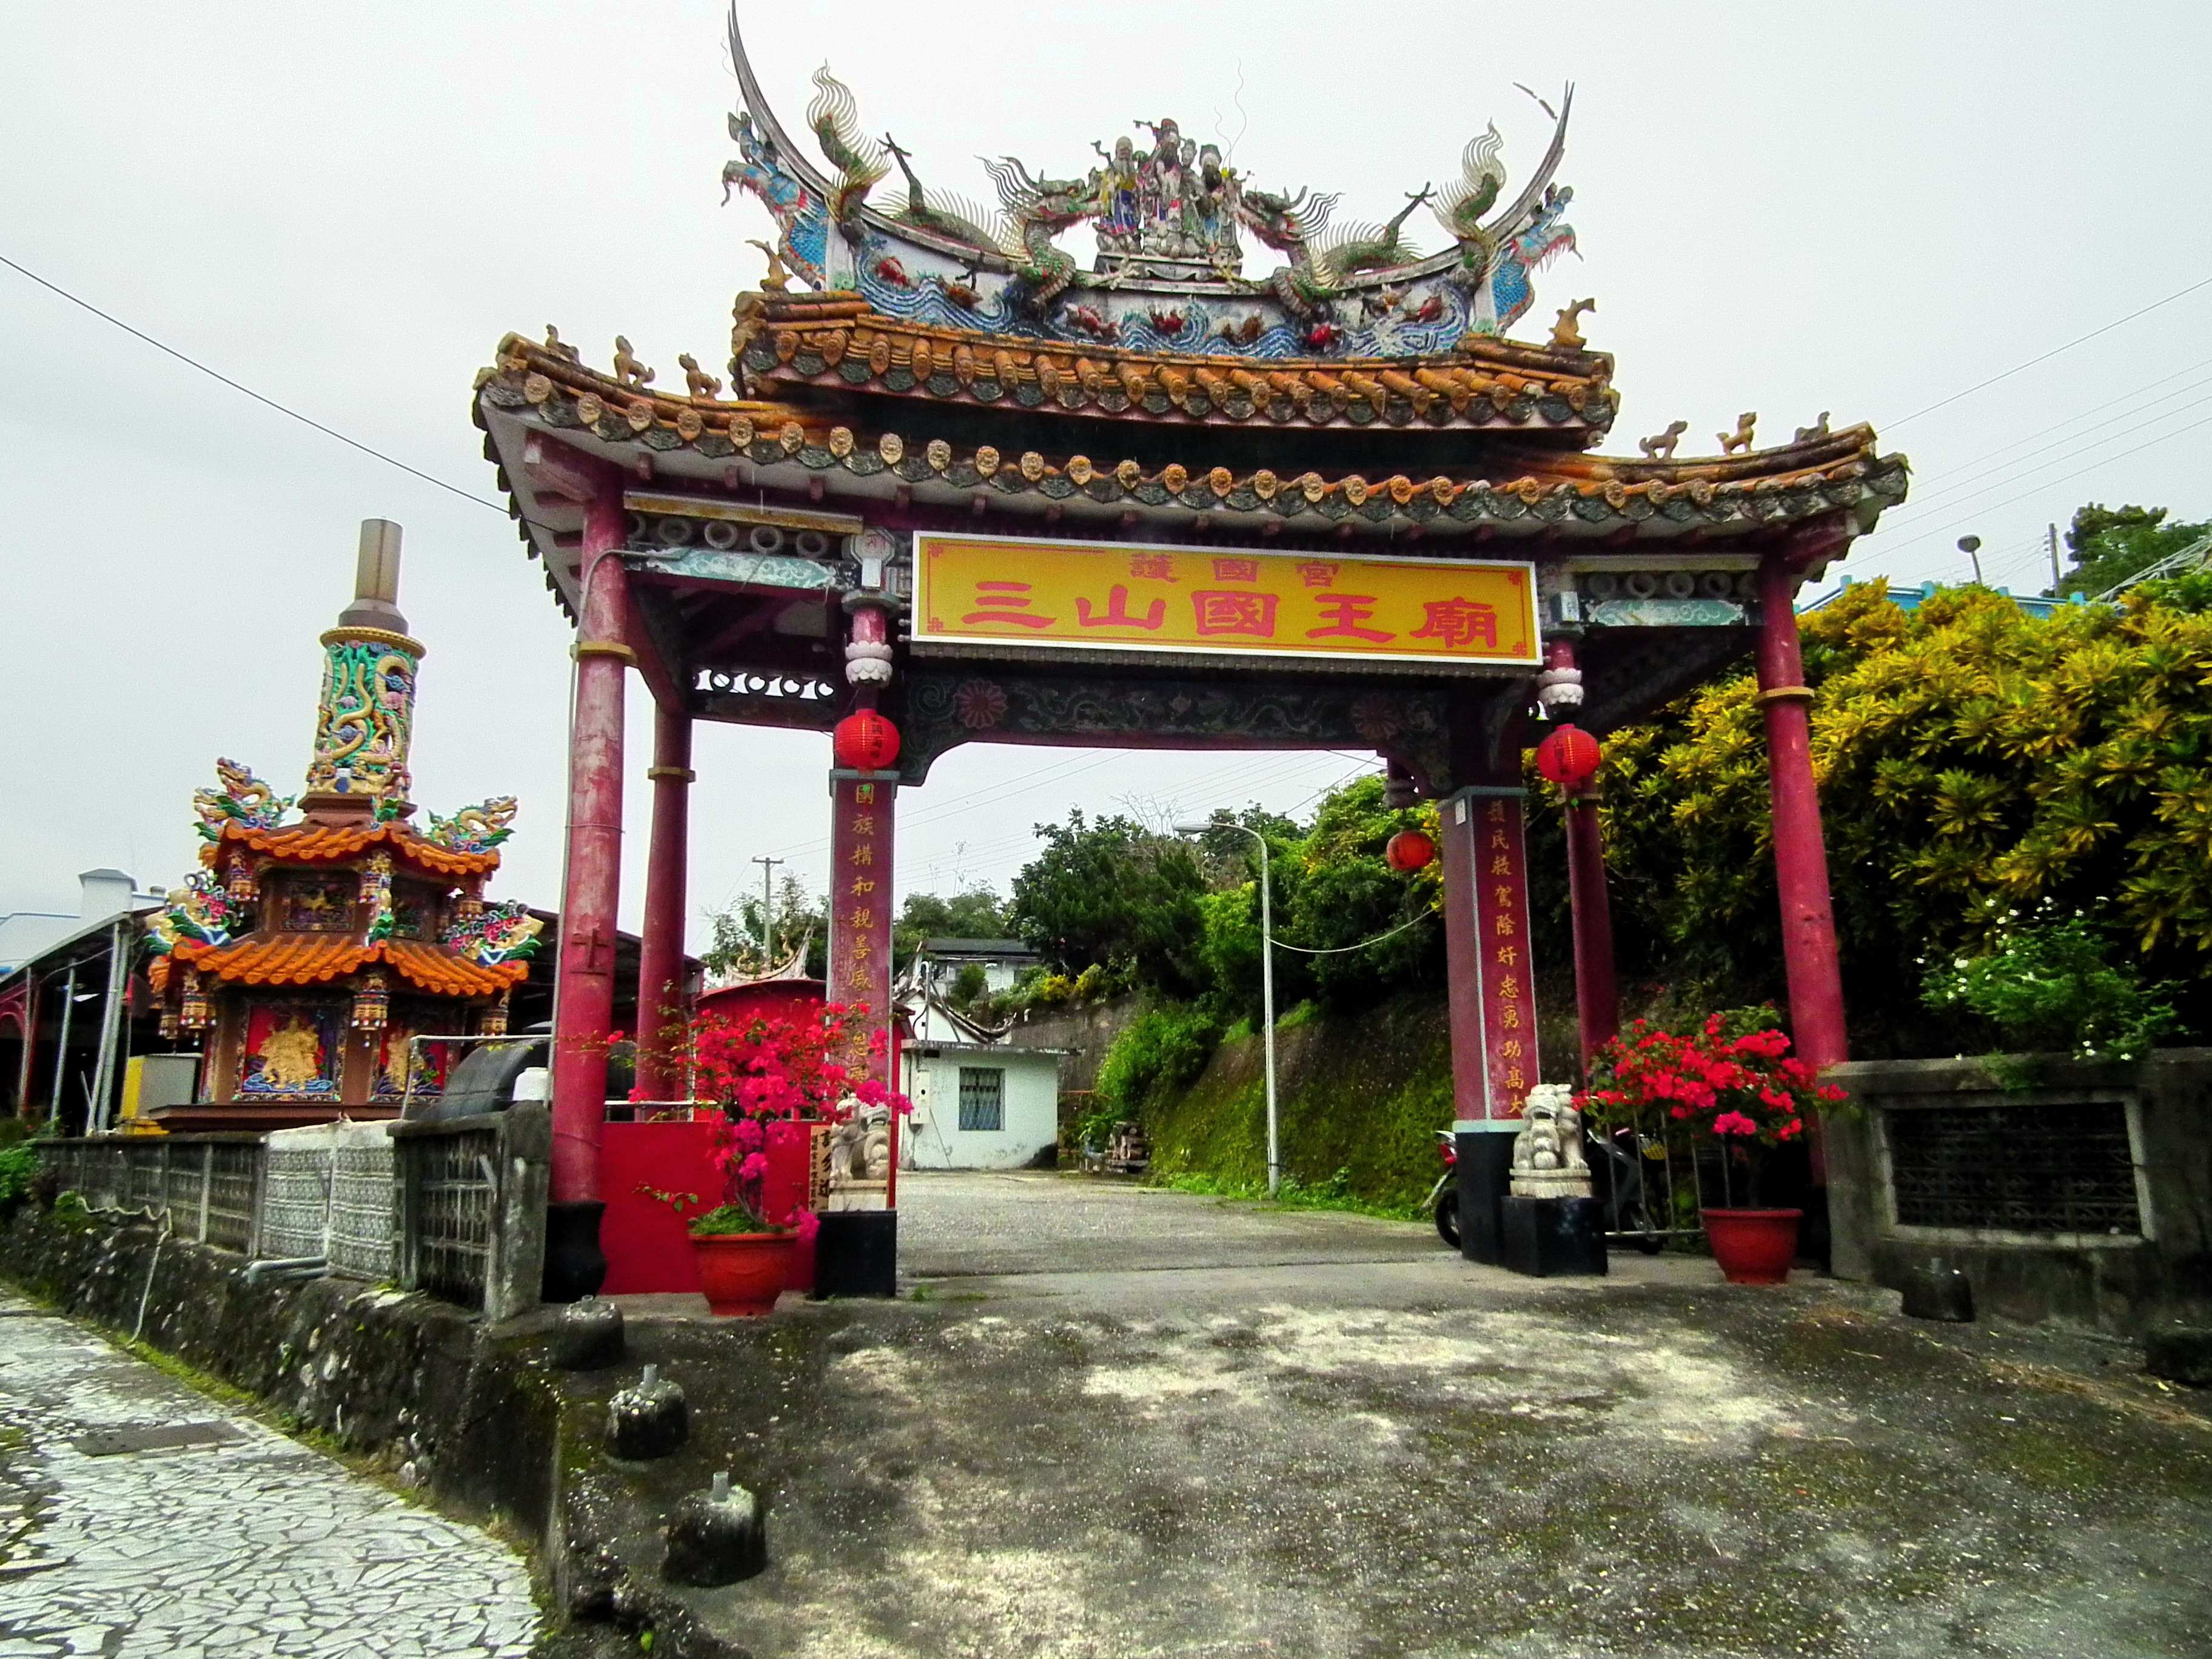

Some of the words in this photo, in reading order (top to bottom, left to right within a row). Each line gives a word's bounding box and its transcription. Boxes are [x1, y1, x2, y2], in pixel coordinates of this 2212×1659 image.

[961, 581, 1497, 649] 三山國王廟
